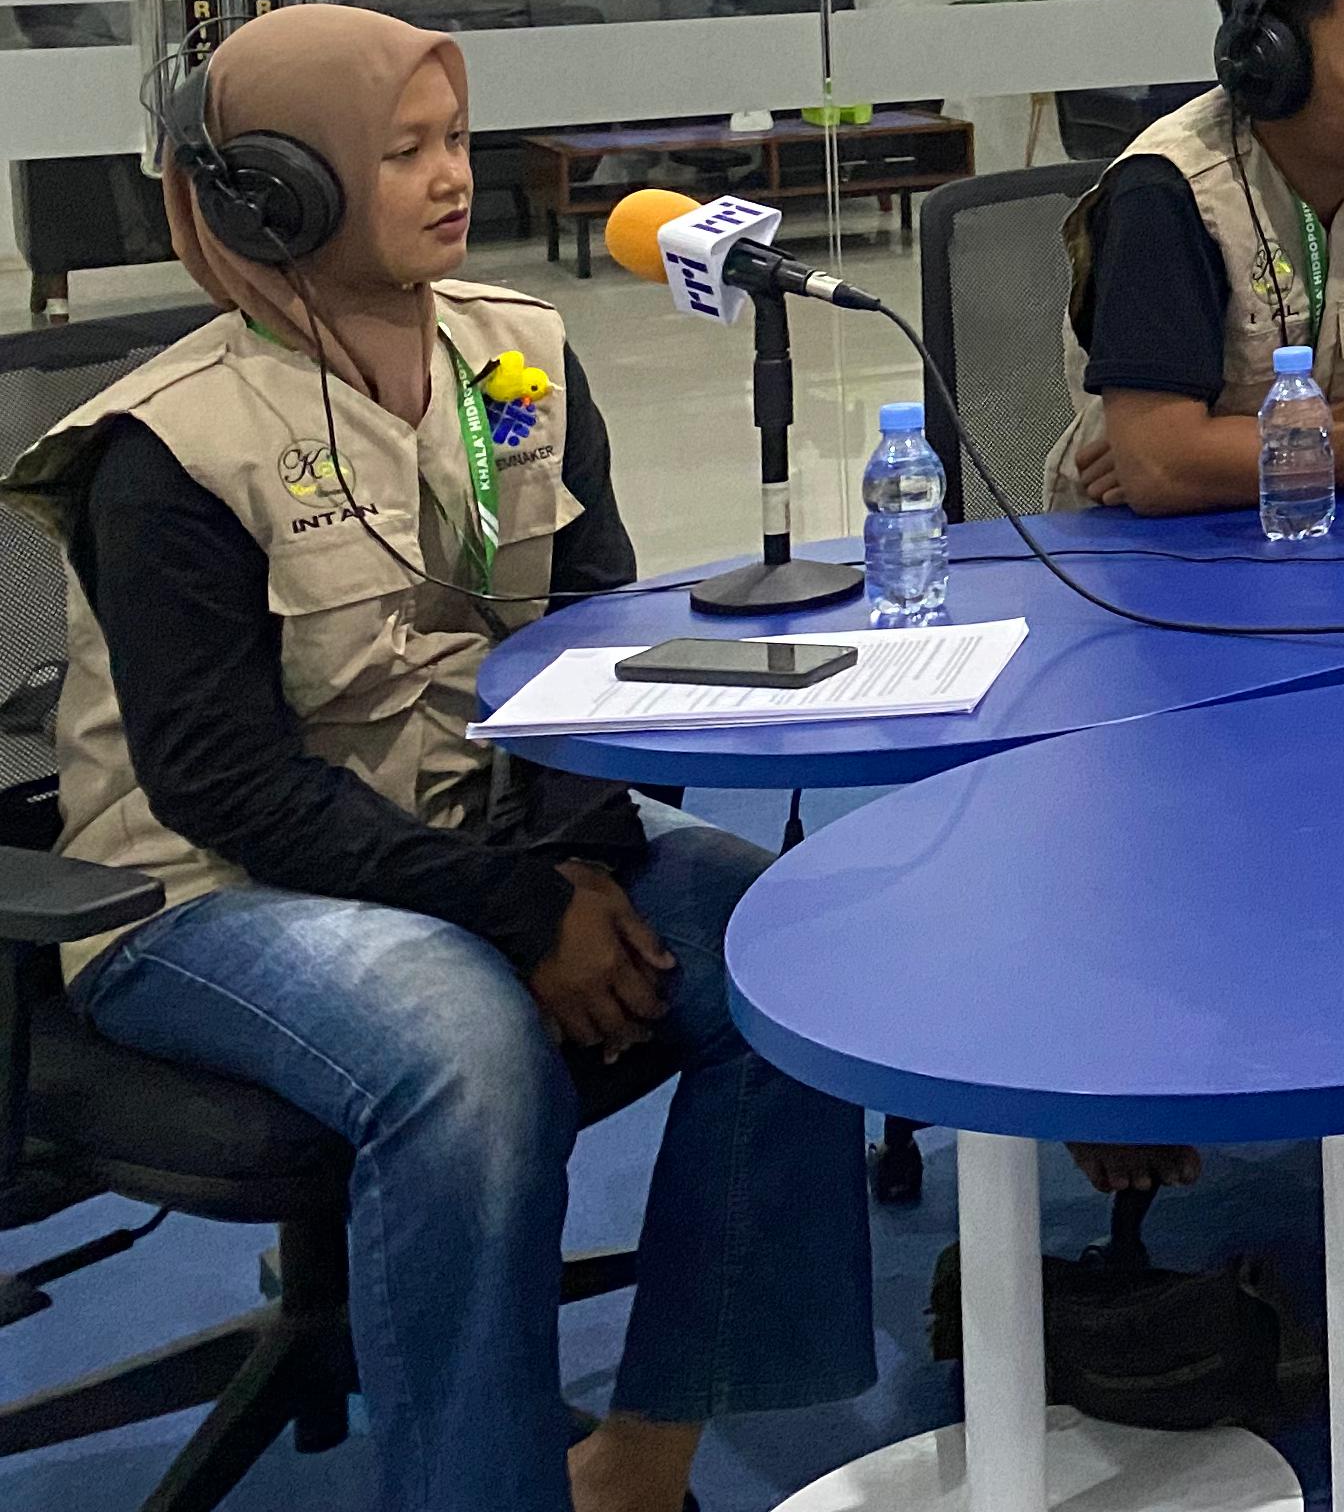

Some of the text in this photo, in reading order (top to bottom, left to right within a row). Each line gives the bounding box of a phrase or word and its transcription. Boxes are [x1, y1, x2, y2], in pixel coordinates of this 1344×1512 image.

[691, 202, 764, 235] rri
[471, 433, 491, 491] KHALA'
[495, 445, 554, 472] EMNAKER
[291, 502, 380, 534] INTAN
